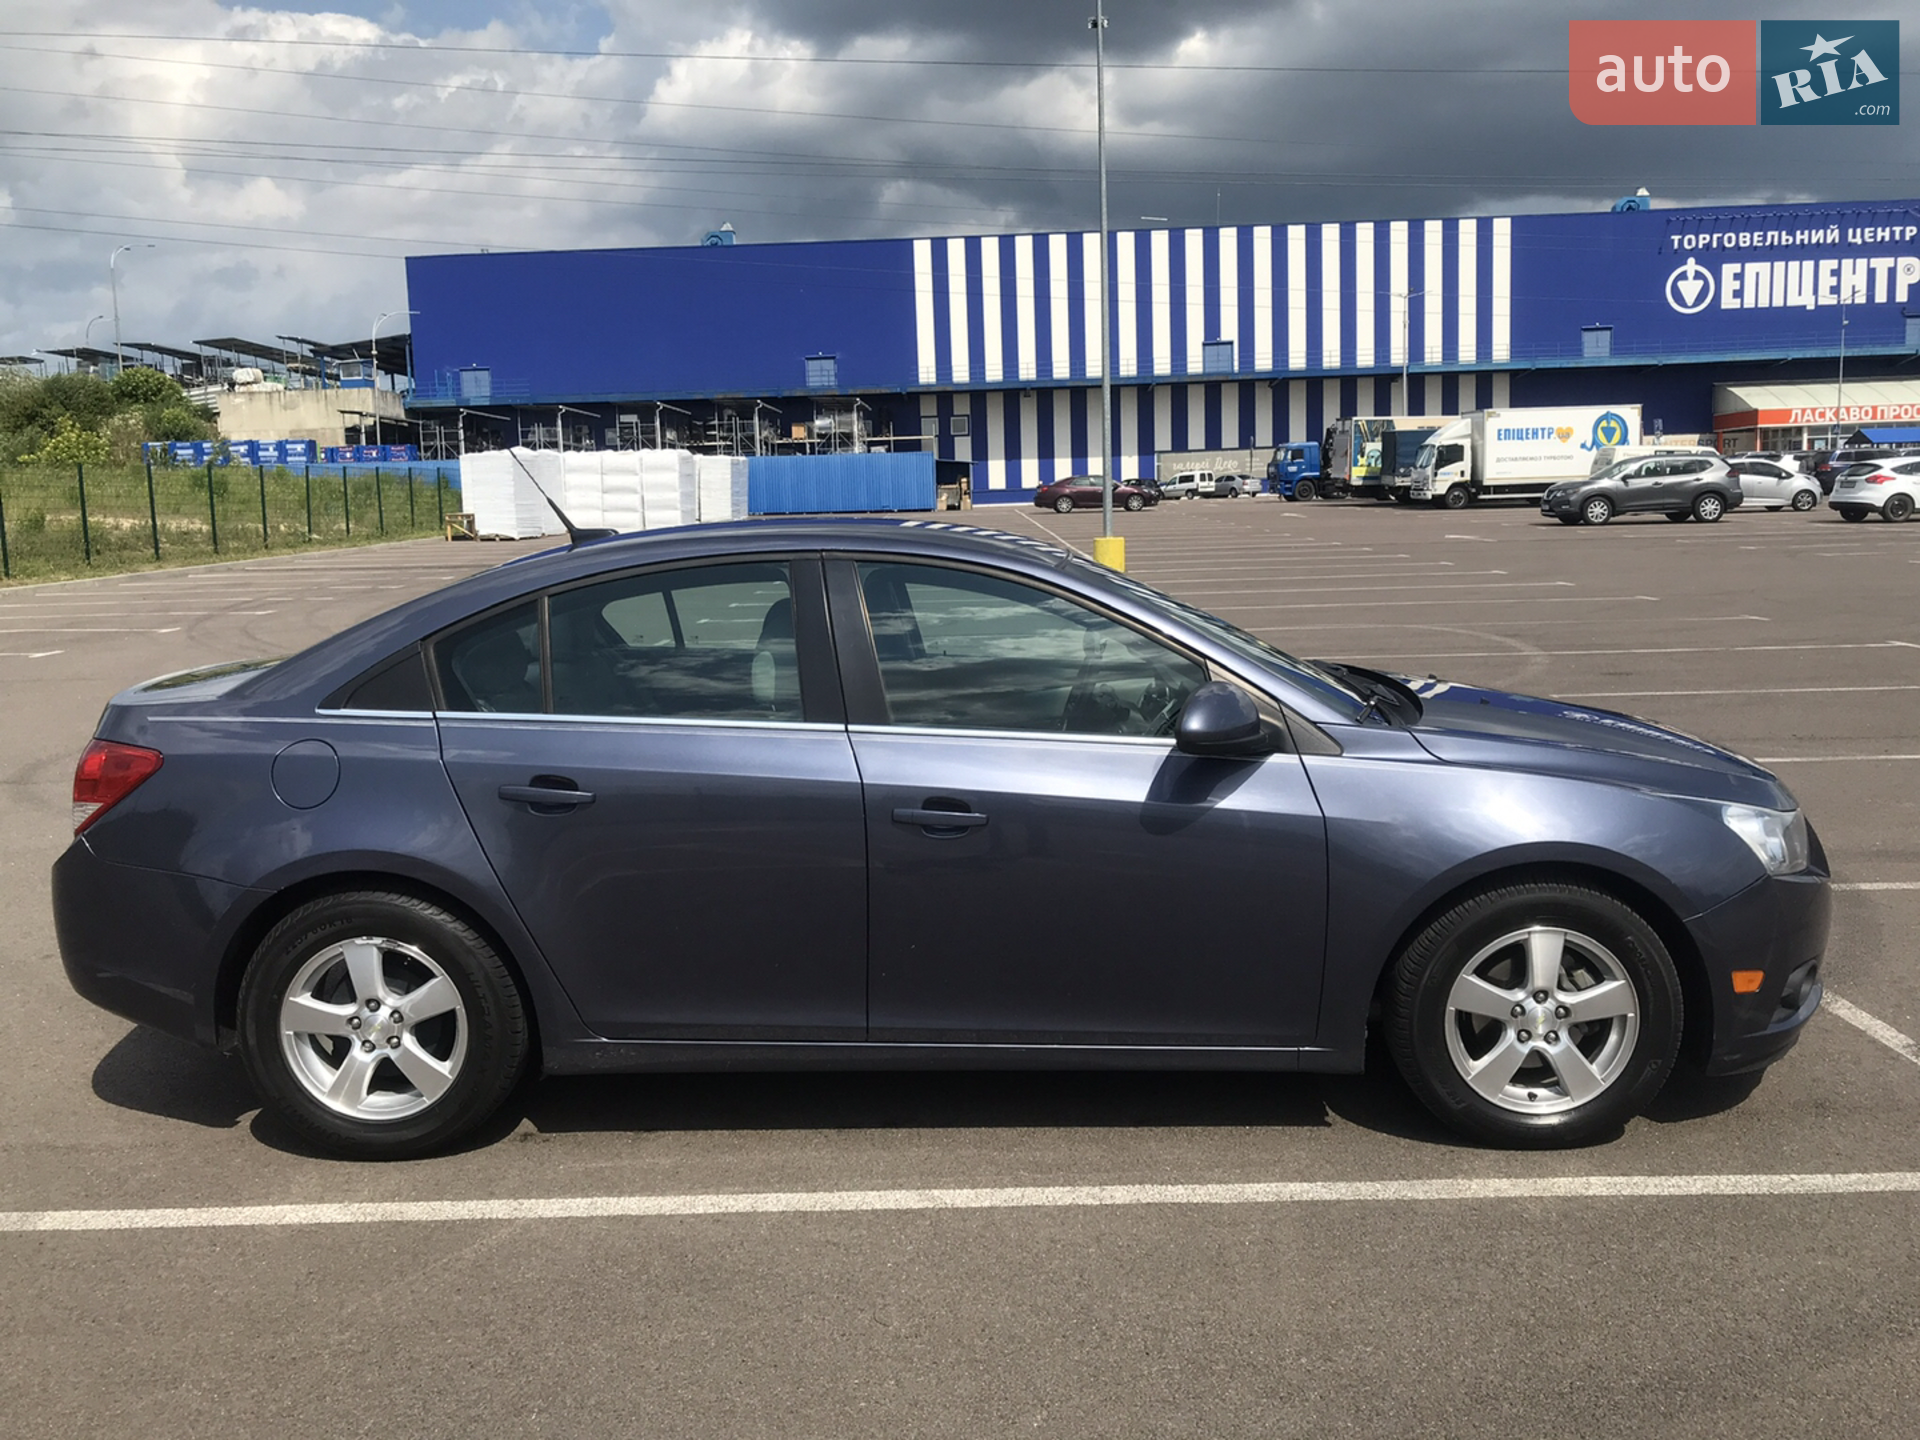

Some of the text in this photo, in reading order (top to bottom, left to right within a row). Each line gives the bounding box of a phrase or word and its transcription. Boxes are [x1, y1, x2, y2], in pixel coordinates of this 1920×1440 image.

[1671, 225, 1918, 250] ТОРГОВЕЛЬНИЙ ЦЕНТР
[1789, 405, 1872, 424] ЛАСКАВО
